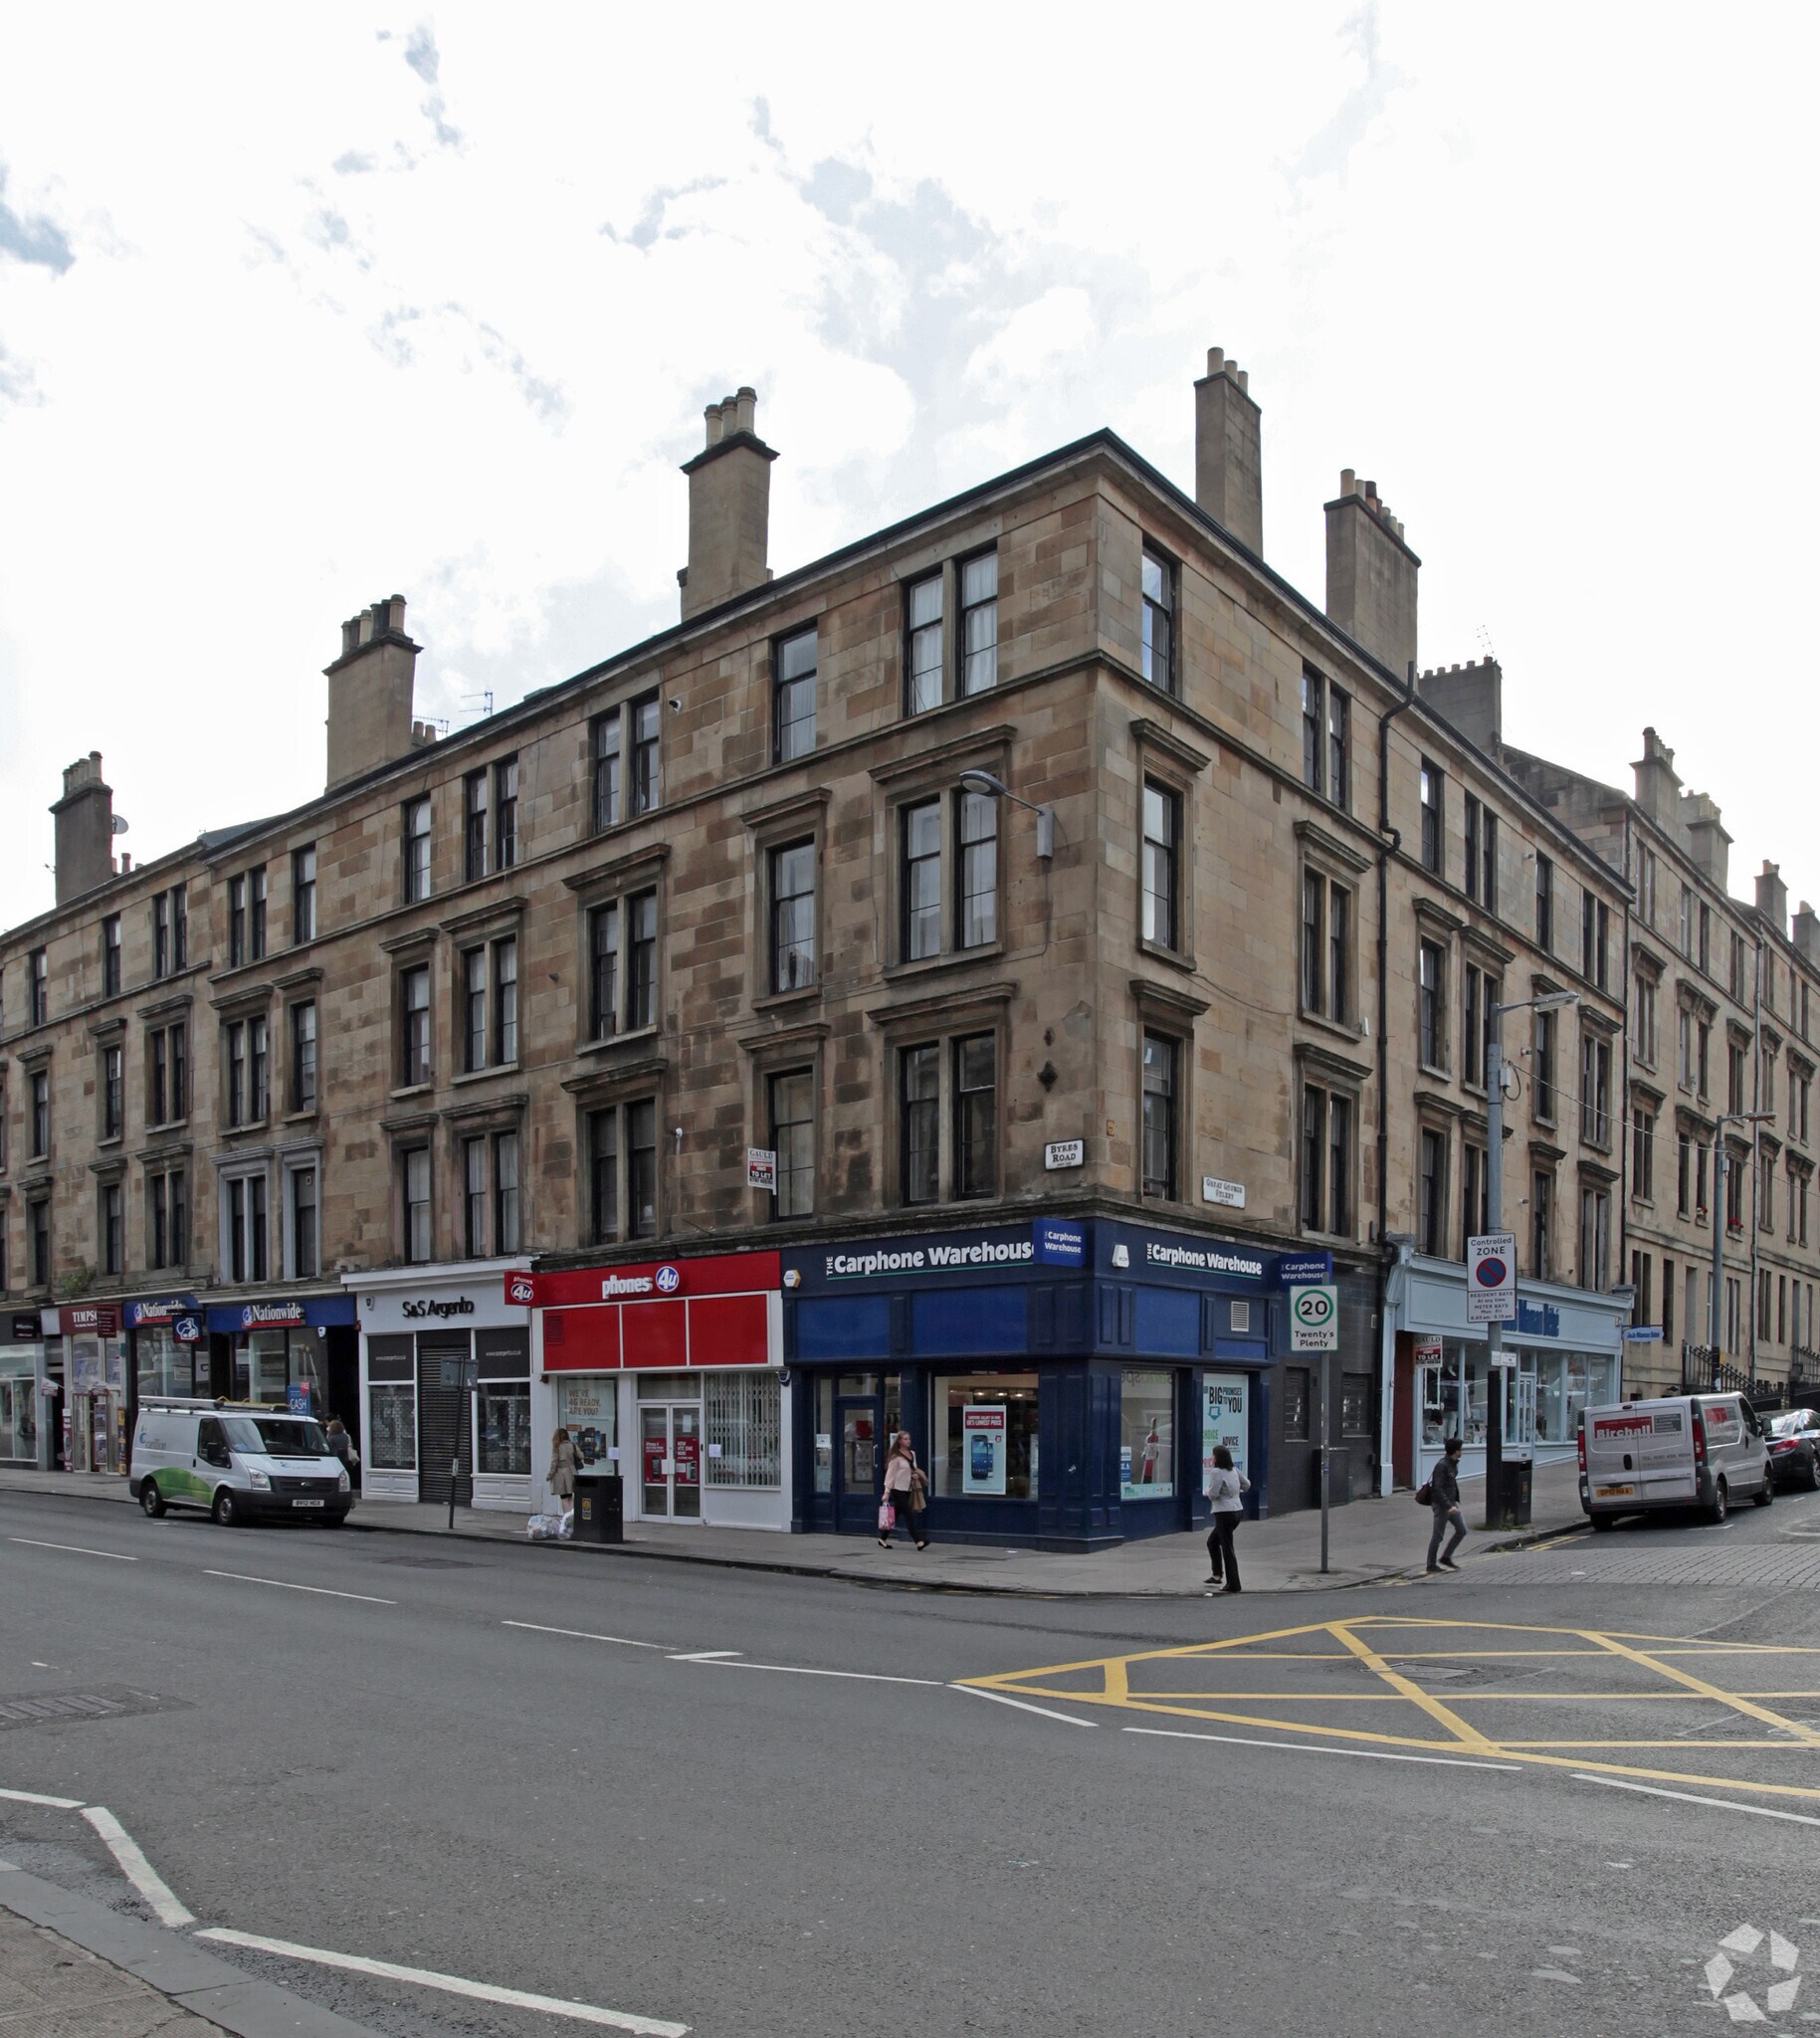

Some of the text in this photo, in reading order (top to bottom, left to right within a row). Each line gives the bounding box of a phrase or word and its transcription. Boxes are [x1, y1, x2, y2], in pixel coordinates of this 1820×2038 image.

[1050, 1143, 1078, 1153] BYRES
[1052, 1153, 1076, 1162] ROAD
[1048, 1230, 1082, 1243] Carphone
[1471, 1238, 1513, 1247] Controlled
[1045, 1242, 1082, 1254] Warehouse
[1477, 1246, 1506, 1256] ZONE
[834, 1250, 924, 1275] Carphone
[927, 1241, 1034, 1266] Warehous
[1152, 1244, 1205, 1267] Carphone
[1206, 1252, 1263, 1276] Warehouse
[513, 1276, 533, 1285] phones
[602, 1268, 678, 1299] phones 4u
[512, 1285, 532, 1300] 4u
[252, 1303, 302, 1322] Nationwide
[402, 1296, 475, 1319] S&S Argento
[1301, 1300, 1328, 1316] 20
[1209, 1386, 1223, 1404] BIG
[290, 1398, 306, 1409] CASH
[1228, 1397, 1242, 1413] YOU
[1596, 1424, 1651, 1440] Birchall
[1223, 1436, 1239, 1446] ADVICE
